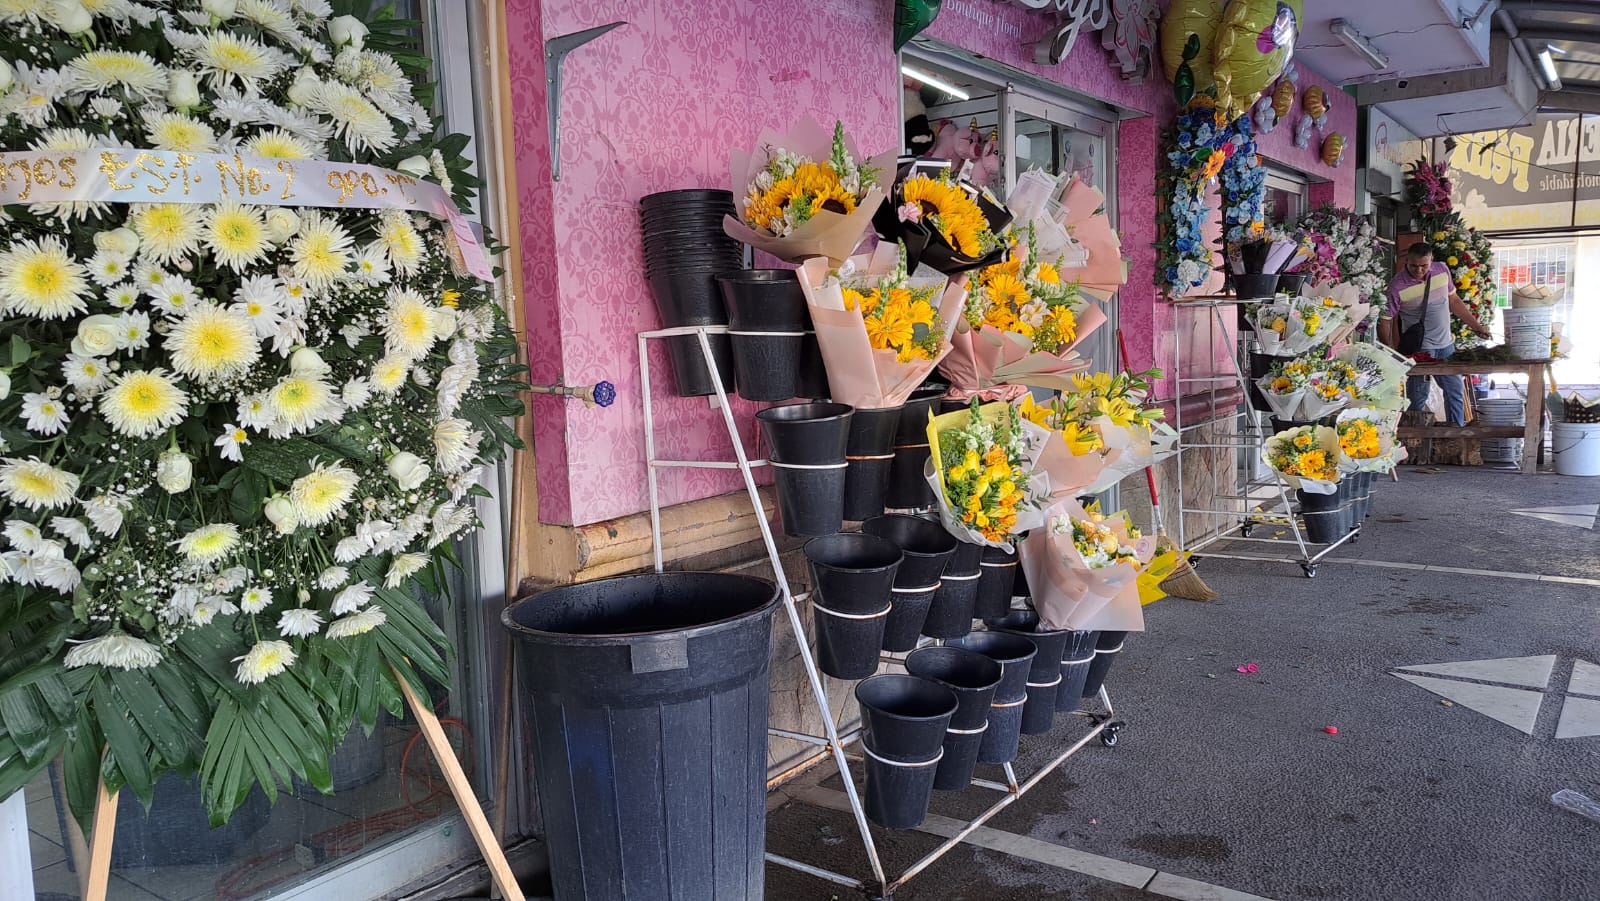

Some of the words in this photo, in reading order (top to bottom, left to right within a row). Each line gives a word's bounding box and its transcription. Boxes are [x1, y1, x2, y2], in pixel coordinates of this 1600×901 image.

[946, 0, 993, 28] Boutique
[995, 12, 1022, 39] floral
[277, 160, 296, 200] 2
